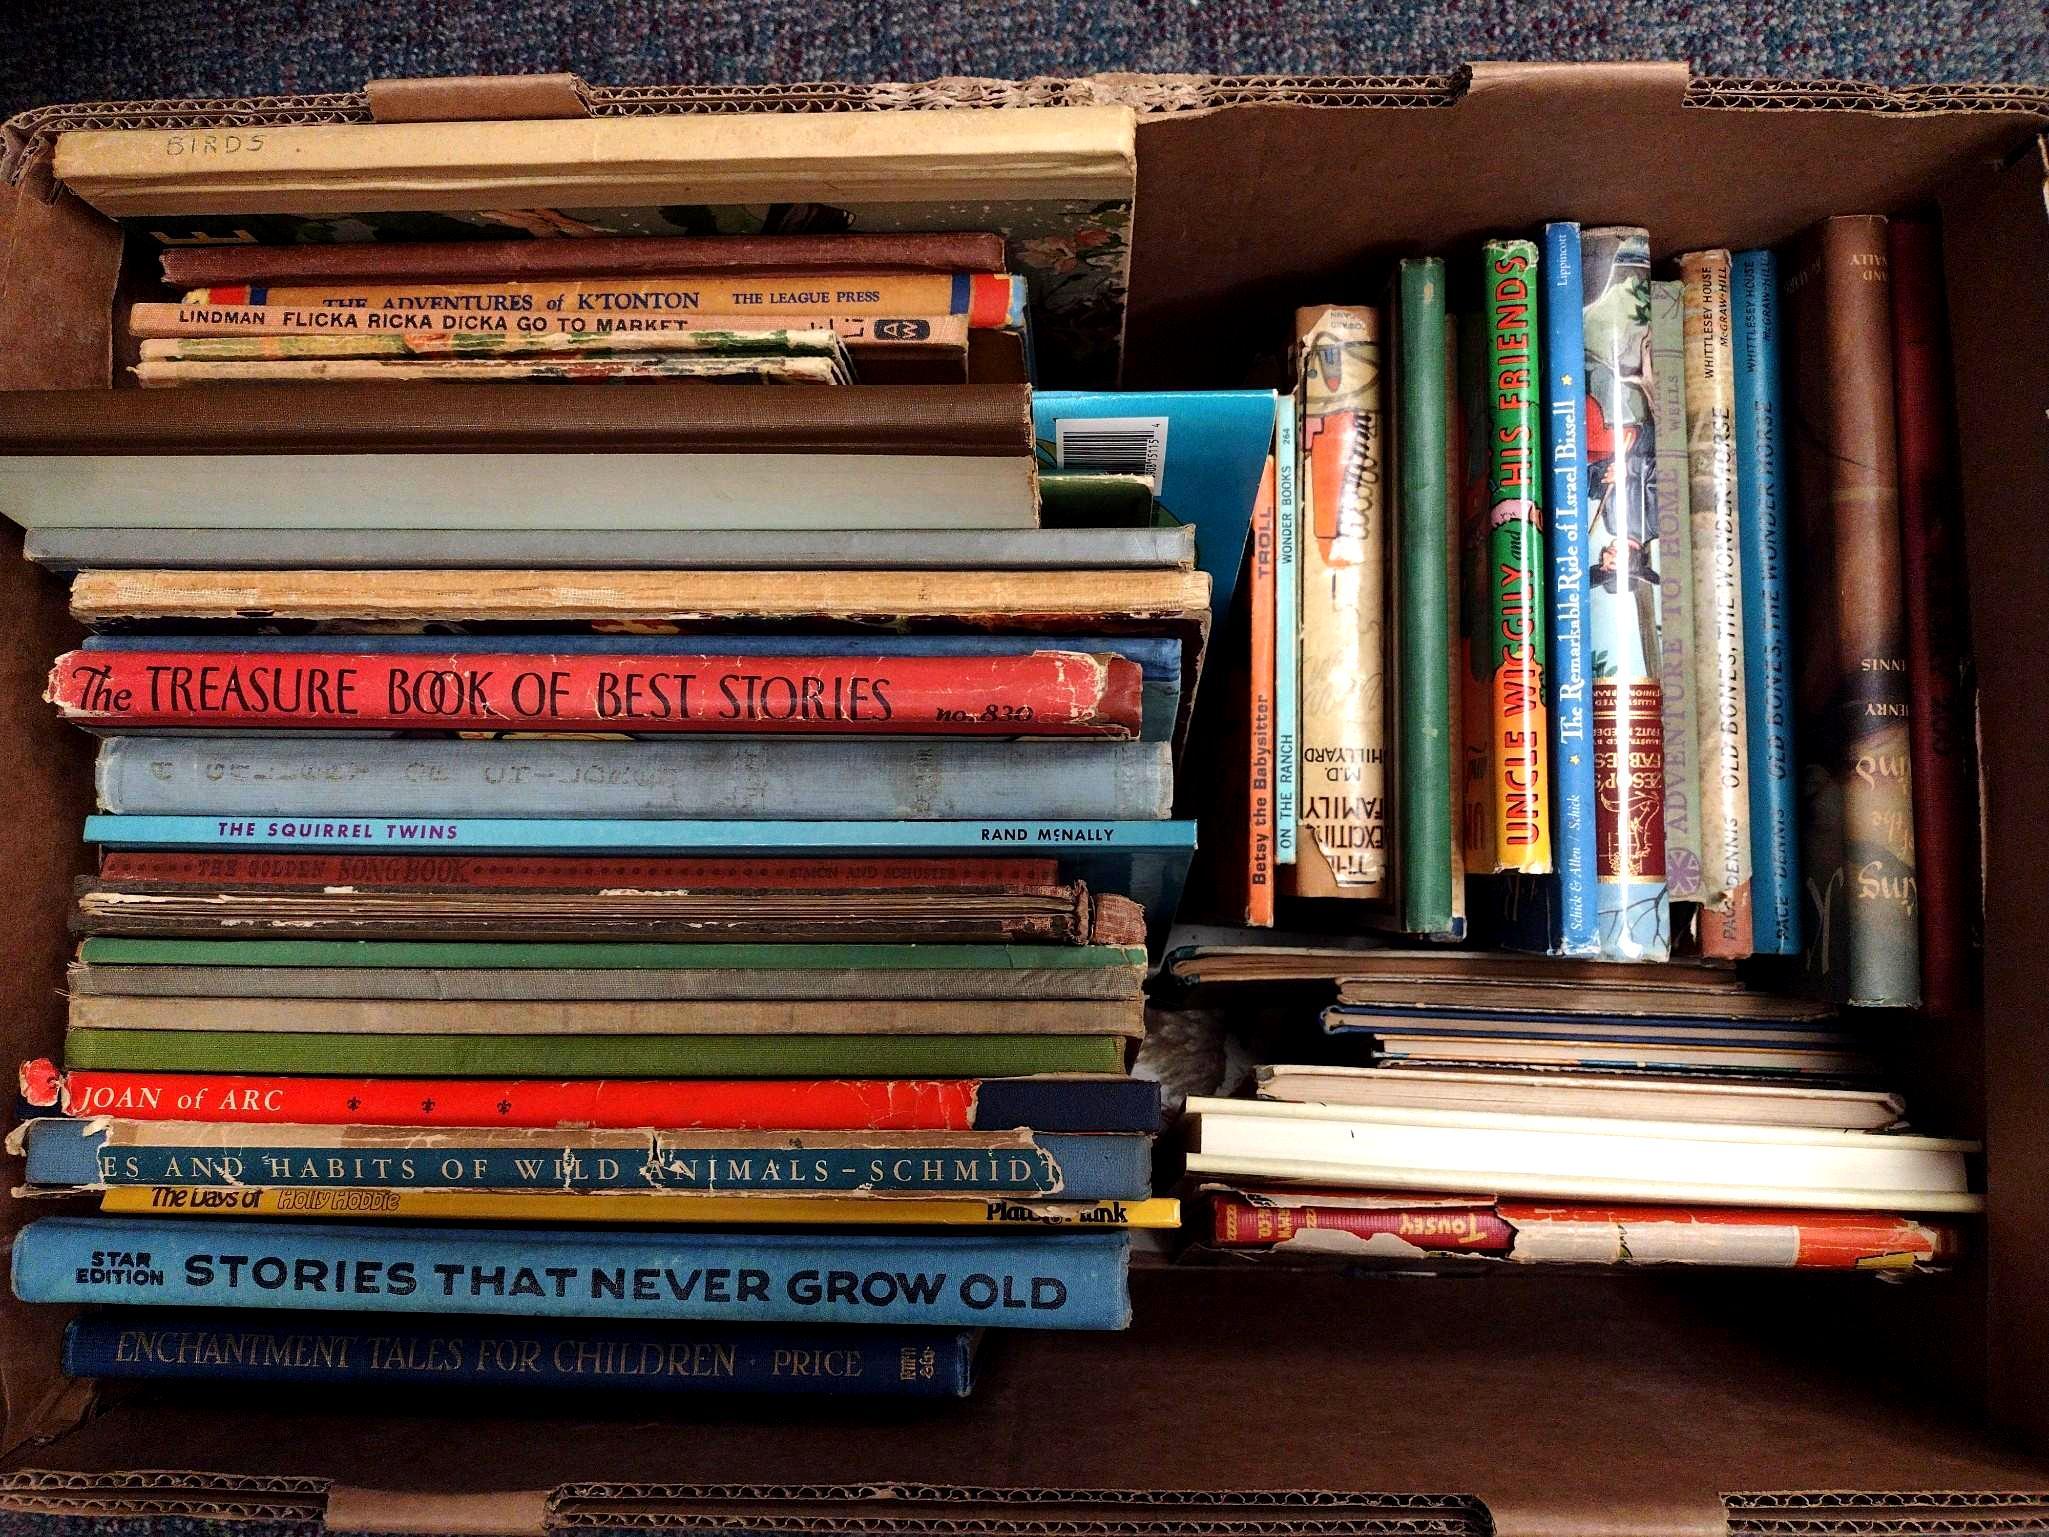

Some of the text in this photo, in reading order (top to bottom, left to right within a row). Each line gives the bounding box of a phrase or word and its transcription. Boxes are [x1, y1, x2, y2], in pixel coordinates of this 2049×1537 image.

[165, 133, 267, 158] BIRDS
[1556, 233, 1568, 287] Lippincott
[323, 289, 880, 311] THE ADVENTURES of K'TONTON THE LEAGUE PRESS
[1719, 266, 1729, 348] McGRAW-HILL
[1744, 261, 1757, 373] WHITTLESEY HOUSE
[179, 310, 266, 325] LINDMAN
[283, 312, 358, 328] FLICKA
[368, 312, 432, 330] RICKA
[443, 314, 508, 331] DICKA
[517, 315, 548, 331] GO
[557, 316, 586, 333] TO
[595, 317, 689, 332] MARKET
[1701, 266, 1715, 379] WHITTLESEY HOUSE
[1280, 427, 1292, 565] WONDER BOOKS 264
[1657, 468, 1681, 559] HOME
[1257, 505, 1273, 580] TROLL
[1495, 254, 1540, 846] UNCLE WIGGILY and HIS FRIENDS
[1553, 400, 1584, 745] The Remarkable Ride of Israel Bissell
[1660, 576, 1683, 617] TO
[71, 664, 132, 713] The
[146, 666, 359, 715] TREASURE
[387, 669, 495, 717] BOOK
[511, 671, 571, 718] OF
[597, 672, 697, 720] BEST
[719, 674, 893, 722] STORIES
[1303, 747, 1384, 763] HILLYARD
[1661, 637, 1689, 834] ADVENTURE
[1324, 767, 1362, 781] M.D.
[1594, 752, 1661, 768] FABES
[1721, 737, 1740, 789] OLD
[1252, 694, 1271, 885] Betsy the Babysitter
[1279, 733, 1292, 849] ON THE RANCH
[1305, 796, 1385, 819] FAMILY
[217, 820, 259, 838] THE
[267, 821, 373, 839] SQUIRREL
[386, 823, 458, 840] TWINS
[981, 827, 1028, 842] RAND
[1568, 793, 1582, 830] Schick
[197, 859, 241, 878] THE
[247, 859, 327, 879] GOLDEN
[1568, 846, 1581, 878] Allen
[1722, 817, 1740, 941] PAG DENNIS
[1569, 898, 1583, 931] Schick
[80, 1086, 283, 1115] JOAN of ARC
[164, 1156, 244, 1179] AND
[269, 1157, 417, 1180] HABITS
[441, 1158, 489, 1180] OF
[516, 1158, 620, 1181] WILD
[151, 1187, 186, 1208] The
[190, 1188, 239, 1209] Days
[277, 1189, 330, 1211] Holly
[75, 1267, 165, 1287] EDITION
[90, 1250, 152, 1269] STAR
[185, 1254, 1068, 1311] STORIES THAT NEVER GROW OLD
[115, 1330, 358, 1370] ENCHANTMENT
[362, 1334, 470, 1374] TALES
[474, 1337, 542, 1375] FOR
[551, 1339, 737, 1379] CHILDREN
[771, 1348, 864, 1379] PRICE
